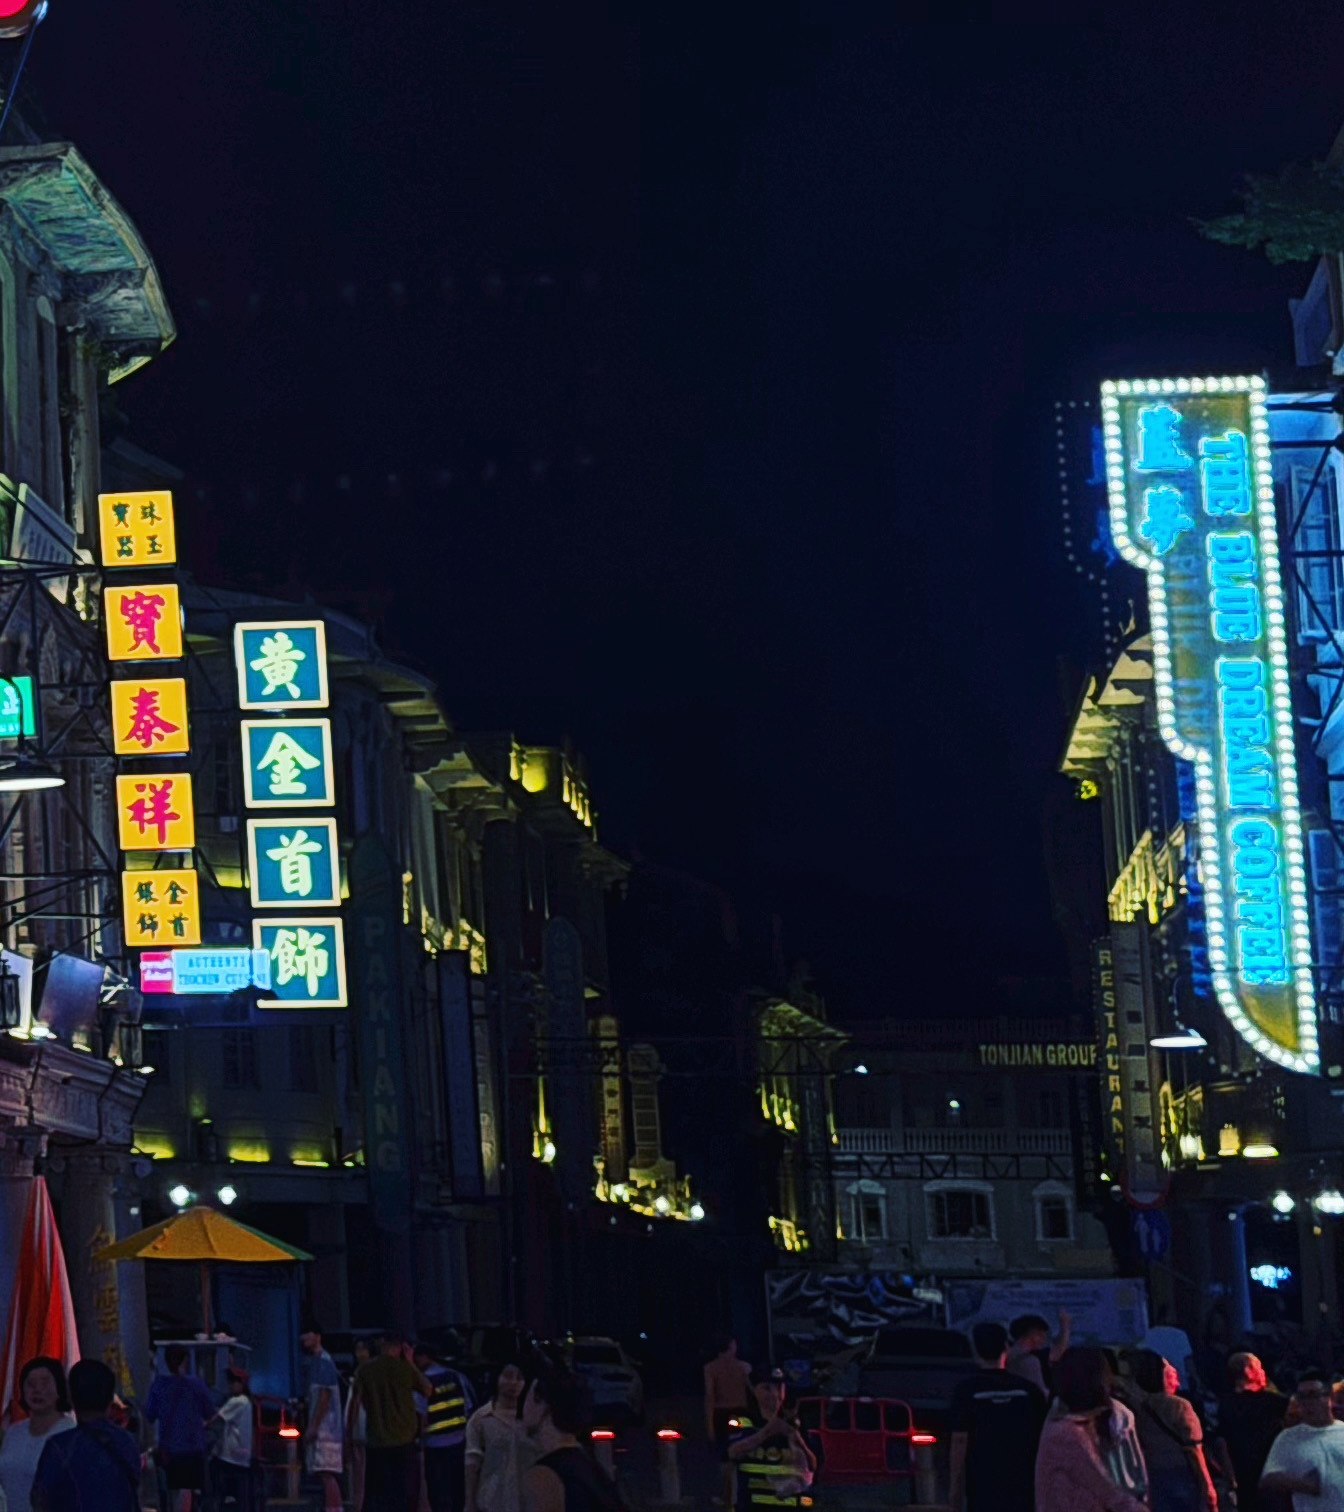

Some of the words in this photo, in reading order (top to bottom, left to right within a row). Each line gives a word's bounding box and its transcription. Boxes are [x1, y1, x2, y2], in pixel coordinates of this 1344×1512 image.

[1199, 429, 1252, 517] THE
[1206, 530, 1262, 643] BLUE
[1214, 654, 1276, 810] DREAM
[1230, 815, 1291, 986] COFFEE
[1098, 948, 1126, 1157] RESTAURANT
